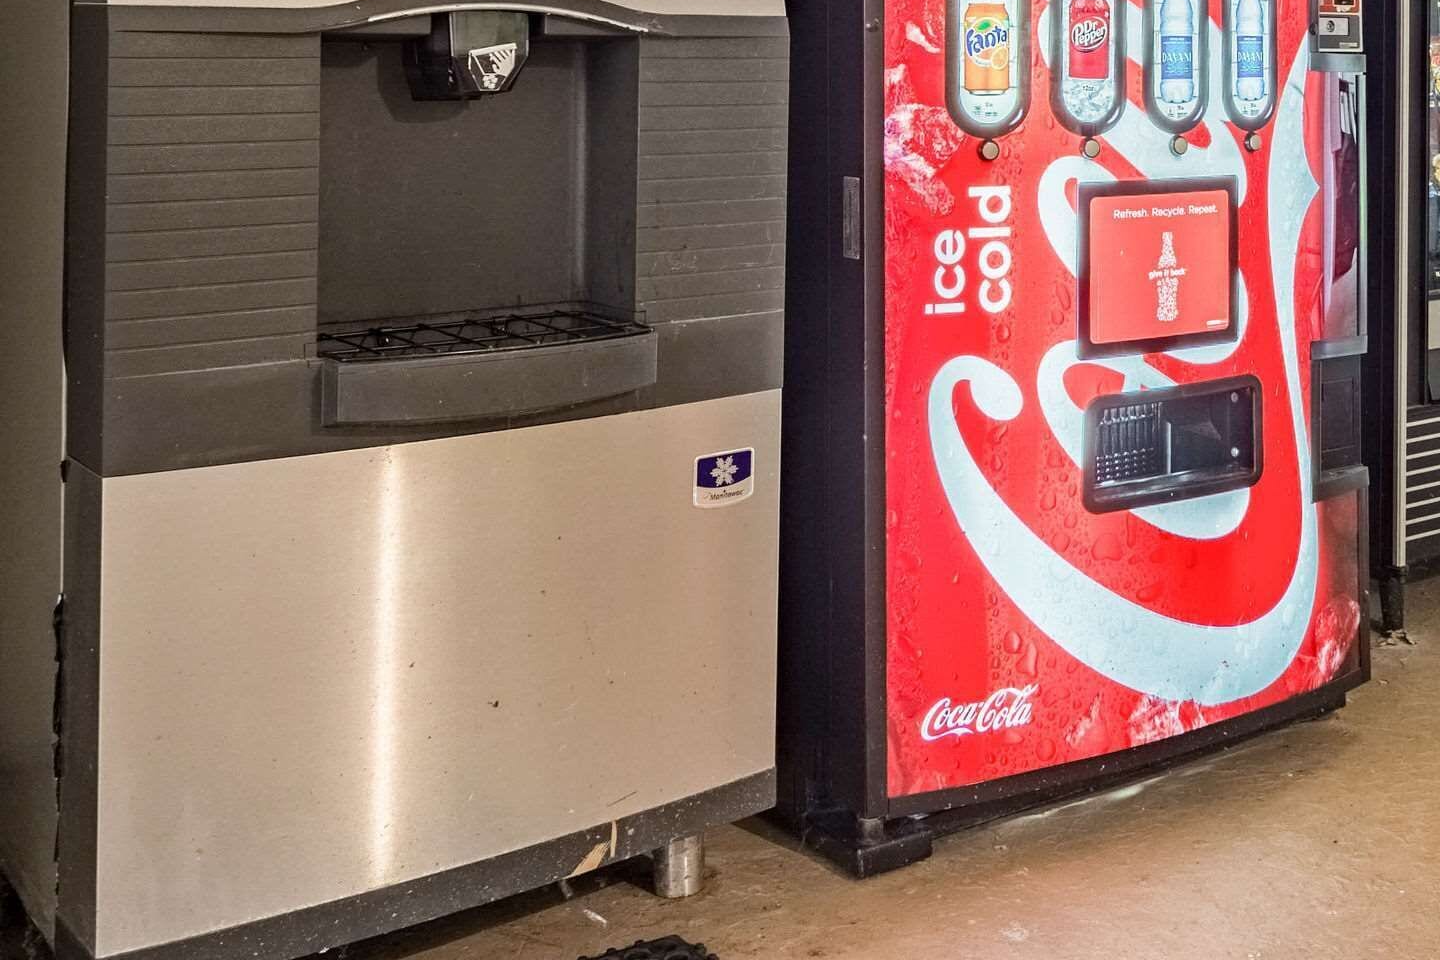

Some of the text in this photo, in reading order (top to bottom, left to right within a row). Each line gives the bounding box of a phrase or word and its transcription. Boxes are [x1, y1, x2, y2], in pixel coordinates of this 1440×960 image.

[966, 26, 1008, 57] Fanta
[1074, 23, 1106, 46] Pepper
[1084, 20, 1098, 33] Dr
[968, 185, 1013, 313] cold
[924, 229, 966, 315] ice
